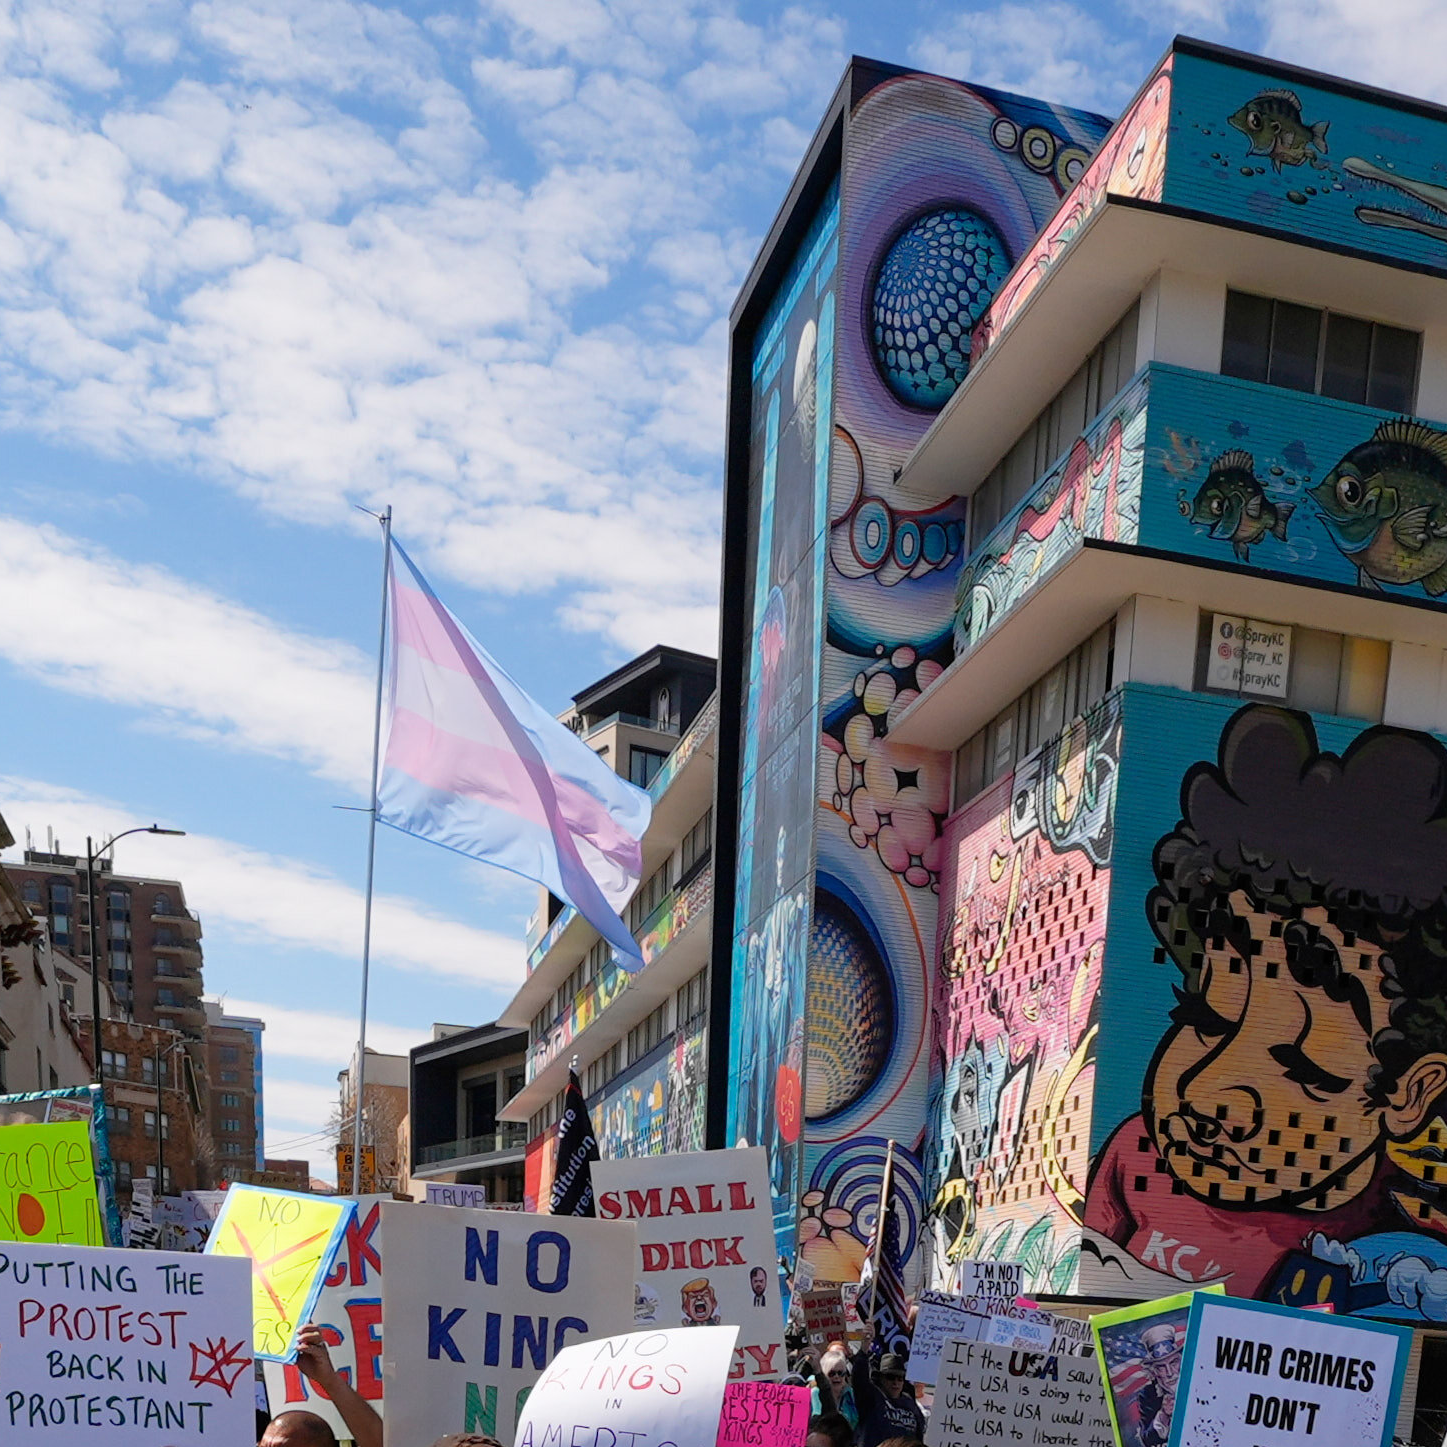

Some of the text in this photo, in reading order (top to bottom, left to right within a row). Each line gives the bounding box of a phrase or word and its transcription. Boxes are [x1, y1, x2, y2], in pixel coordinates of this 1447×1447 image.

[259, 1197, 300, 1224] NO
[429, 1188, 485, 1208] TRUMP
[599, 1181, 756, 1221] SMALL
[464, 1226, 571, 1294] NO
[641, 1236, 748, 1273] DICK
[157, 1263, 205, 1296] THE
[999, 1265, 1023, 1280] NOT
[960, 1299, 978, 1311] NO
[19, 1299, 188, 1350] PROTEST
[594, 1333, 670, 1361] NO
[946, 1341, 975, 1365] If
[980, 1352, 1003, 1371] the
[1008, 1350, 1059, 1382] USA
[1066, 1370, 1094, 1384] saw
[46, 1350, 168, 1386] BACK IN
[540, 1365, 689, 1395] KINGS
[1215, 1336, 1376, 1393] WAR CRIMES
[605, 1397, 623, 1410] IN
[946, 1373, 1092, 1405] the USA is doing to
[5, 1391, 214, 1435] PROTESTANT
[945, 1394, 980, 1414] USA,
[982, 1399, 1007, 1416] the
[1013, 1402, 1041, 1422] USA
[1051, 1410, 1084, 1426] would
[940, 1416, 965, 1434] the
[974, 1420, 1003, 1437] USA
[1010, 1427, 1023, 1440] to
[1033, 1427, 1079, 1447] liberate
